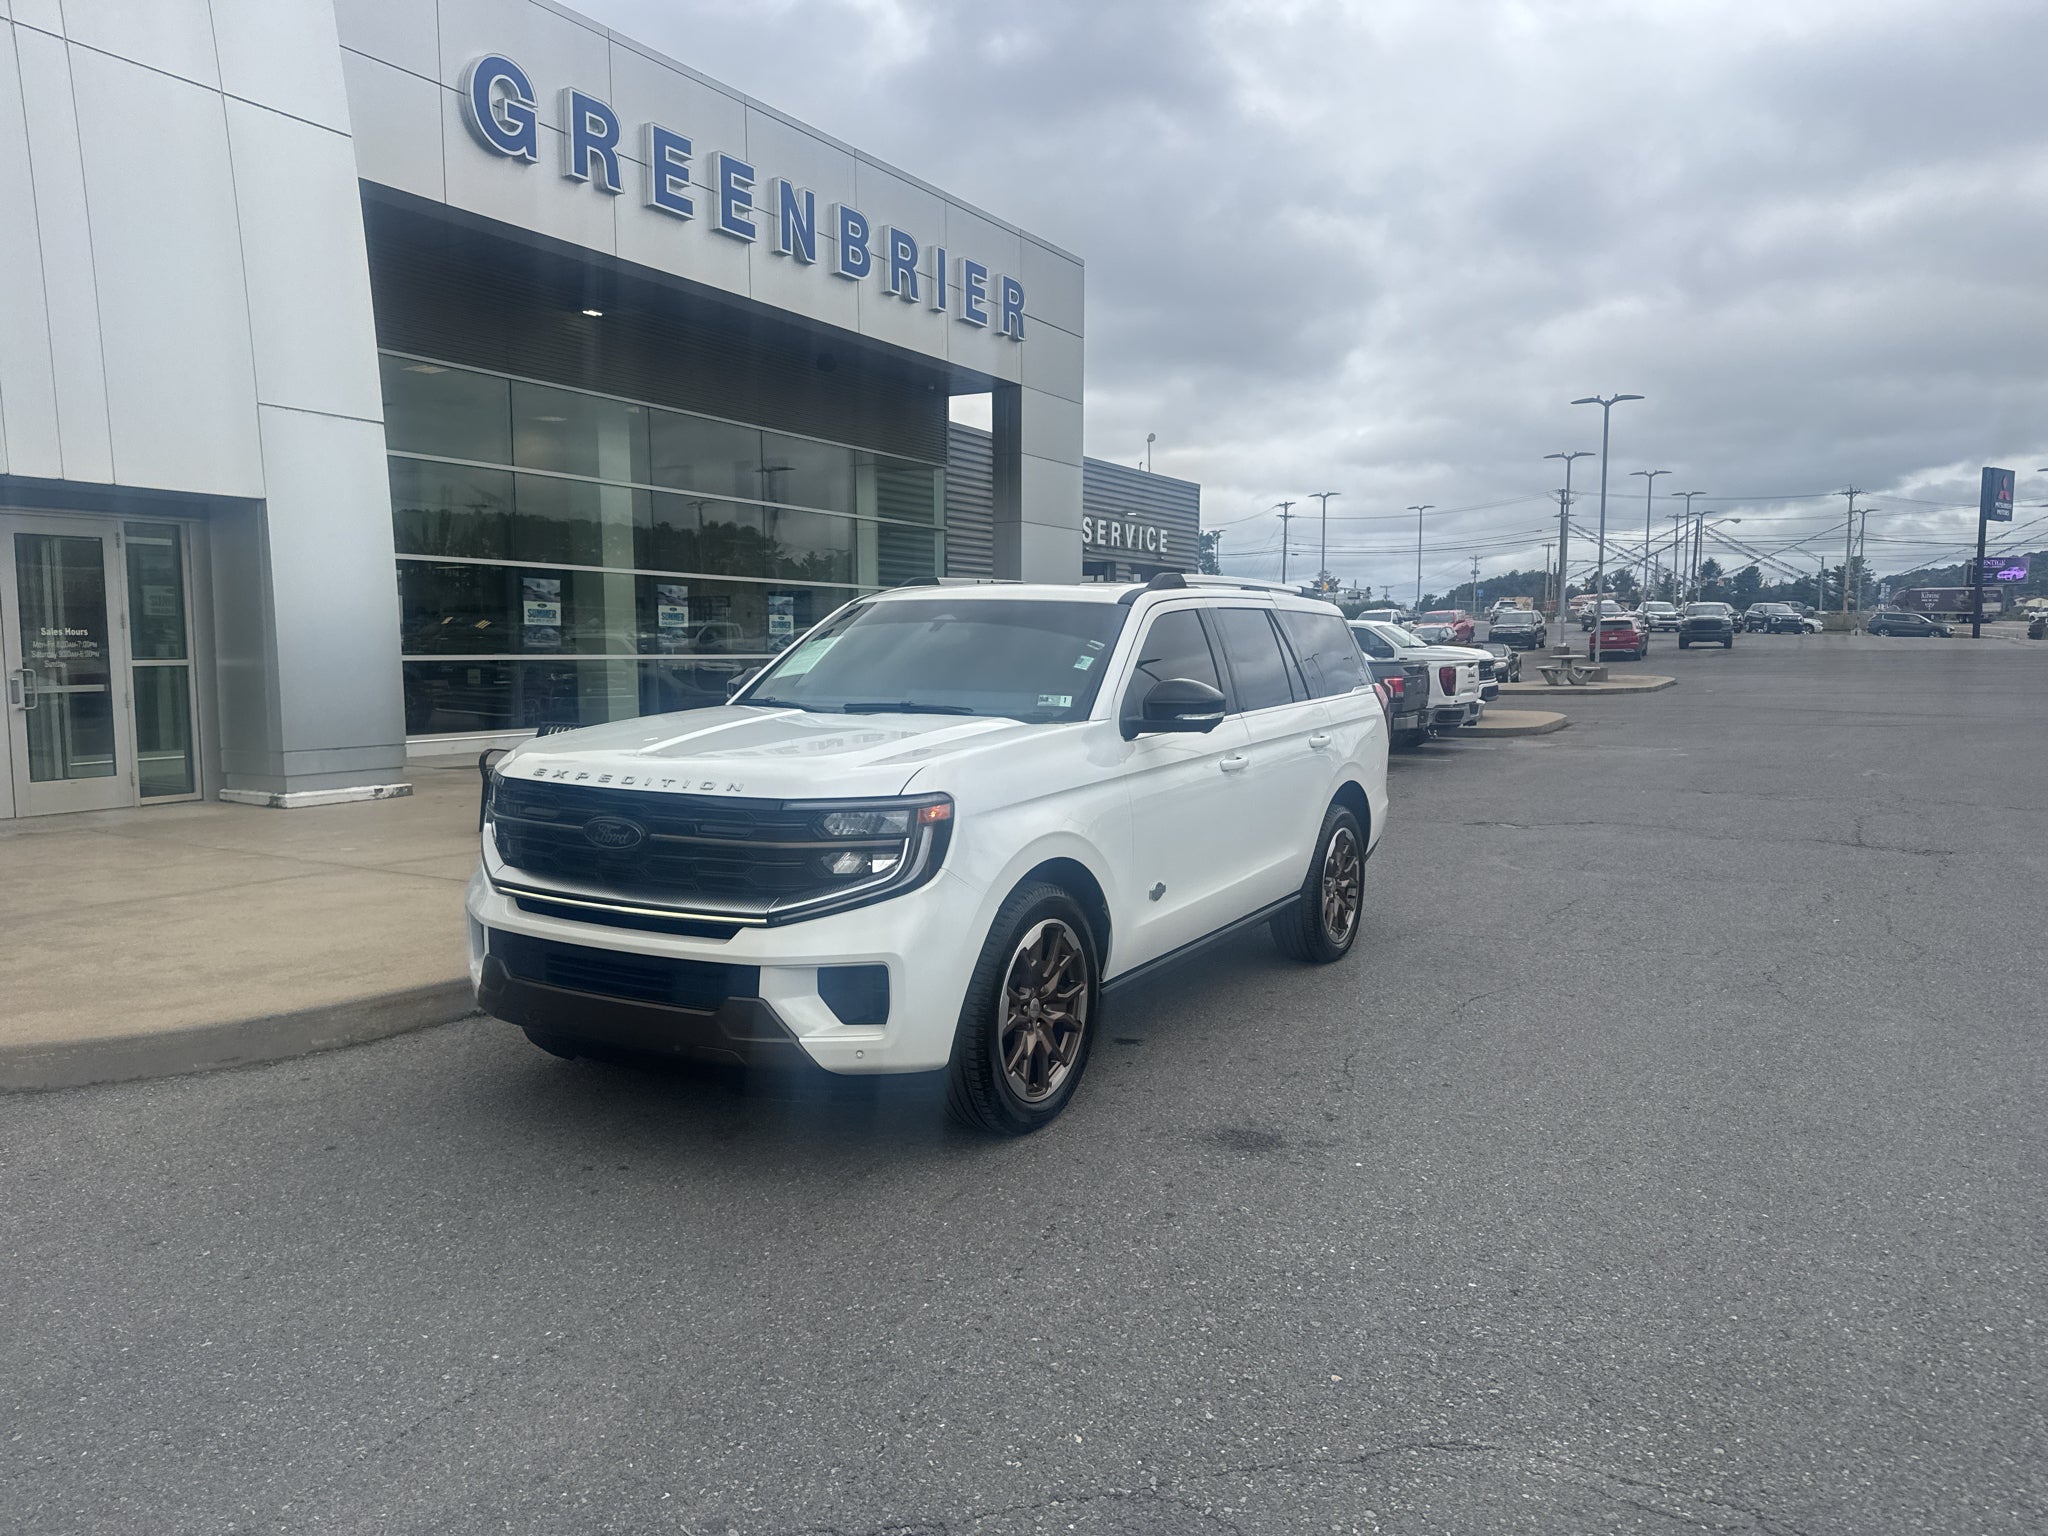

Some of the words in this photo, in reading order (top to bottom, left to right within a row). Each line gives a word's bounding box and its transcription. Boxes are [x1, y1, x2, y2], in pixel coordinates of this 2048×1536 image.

[462, 53, 1026, 342] GREENBRIER
[1082, 516, 1168, 552] SERVICE
[41, 627, 63, 636] Sales
[64, 627, 89, 636] Hours
[532, 767, 745, 792] EXPEDITION
[595, 823, 631, 844] Ford
